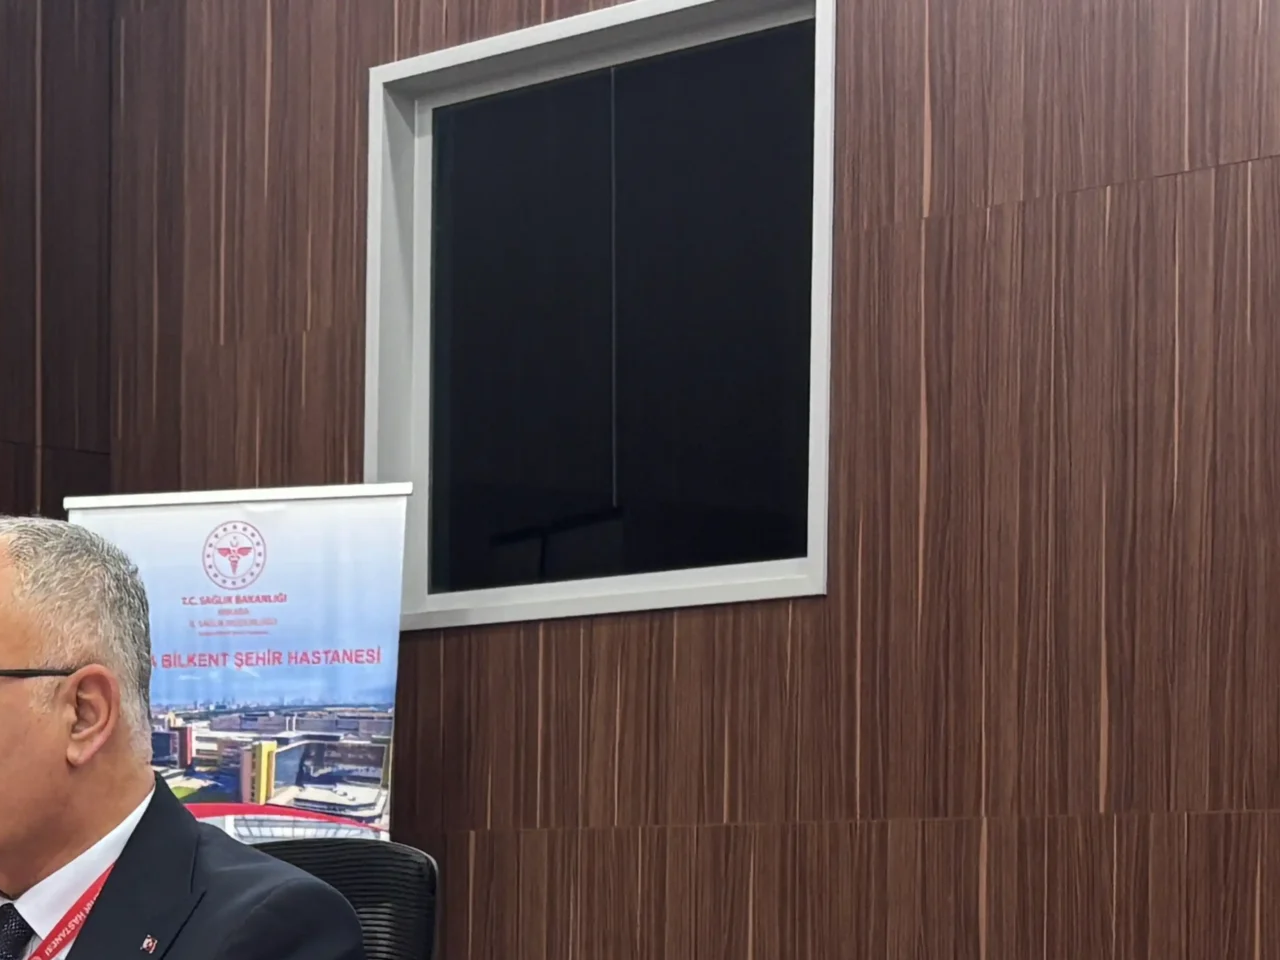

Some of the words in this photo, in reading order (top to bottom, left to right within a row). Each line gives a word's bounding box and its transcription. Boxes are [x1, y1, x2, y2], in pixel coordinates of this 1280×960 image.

[162, 651, 229, 669] BİLKENT
[234, 648, 282, 671] ŞEHİR
[288, 645, 381, 665] HASTANESİ
